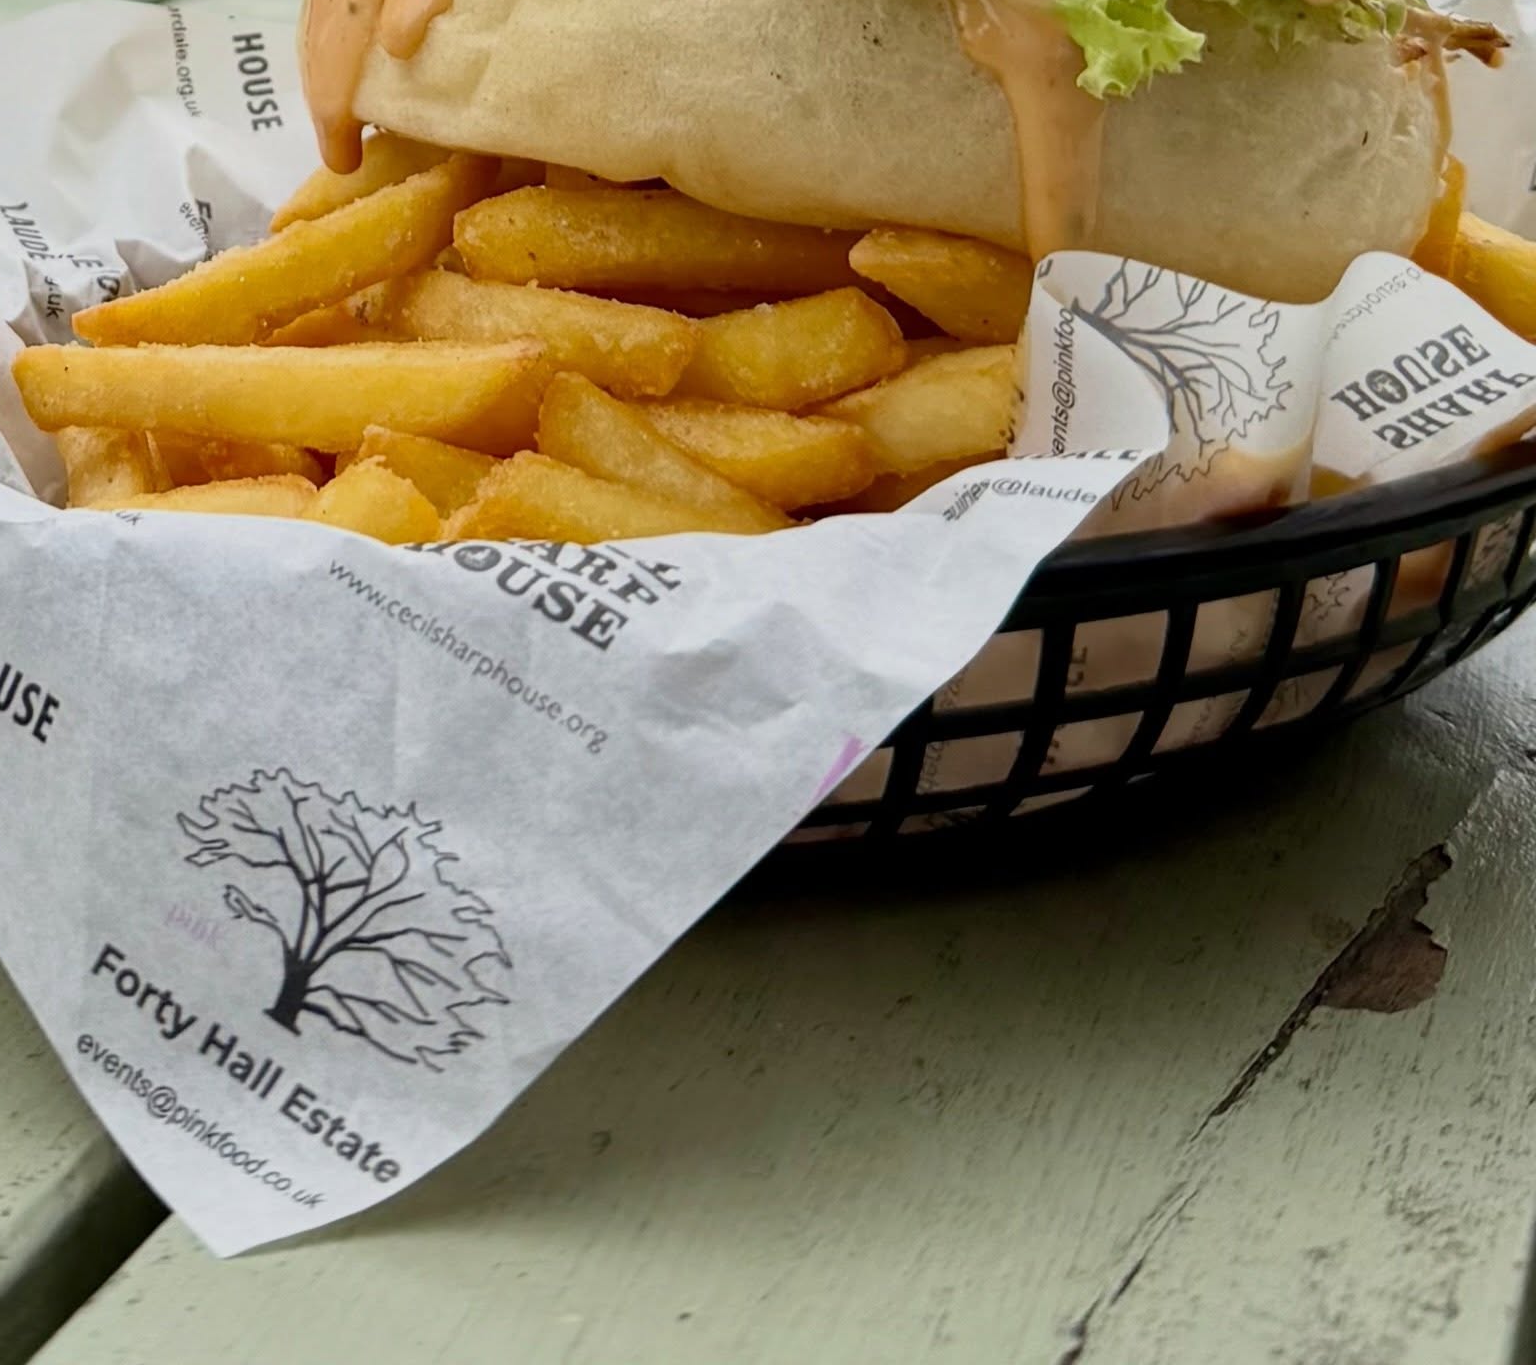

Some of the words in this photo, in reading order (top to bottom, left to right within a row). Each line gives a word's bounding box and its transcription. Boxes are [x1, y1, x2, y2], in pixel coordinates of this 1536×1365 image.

[232, 32, 284, 132] HOUSE
[329, 556, 610, 756] www.cecilsharphouse.org
[76, 1031, 327, 1211] events@pinkfood.co.uk
[91, 943, 198, 1042] Forty
[199, 1021, 284, 1100] Hall
[279, 1082, 403, 1185] Estate
